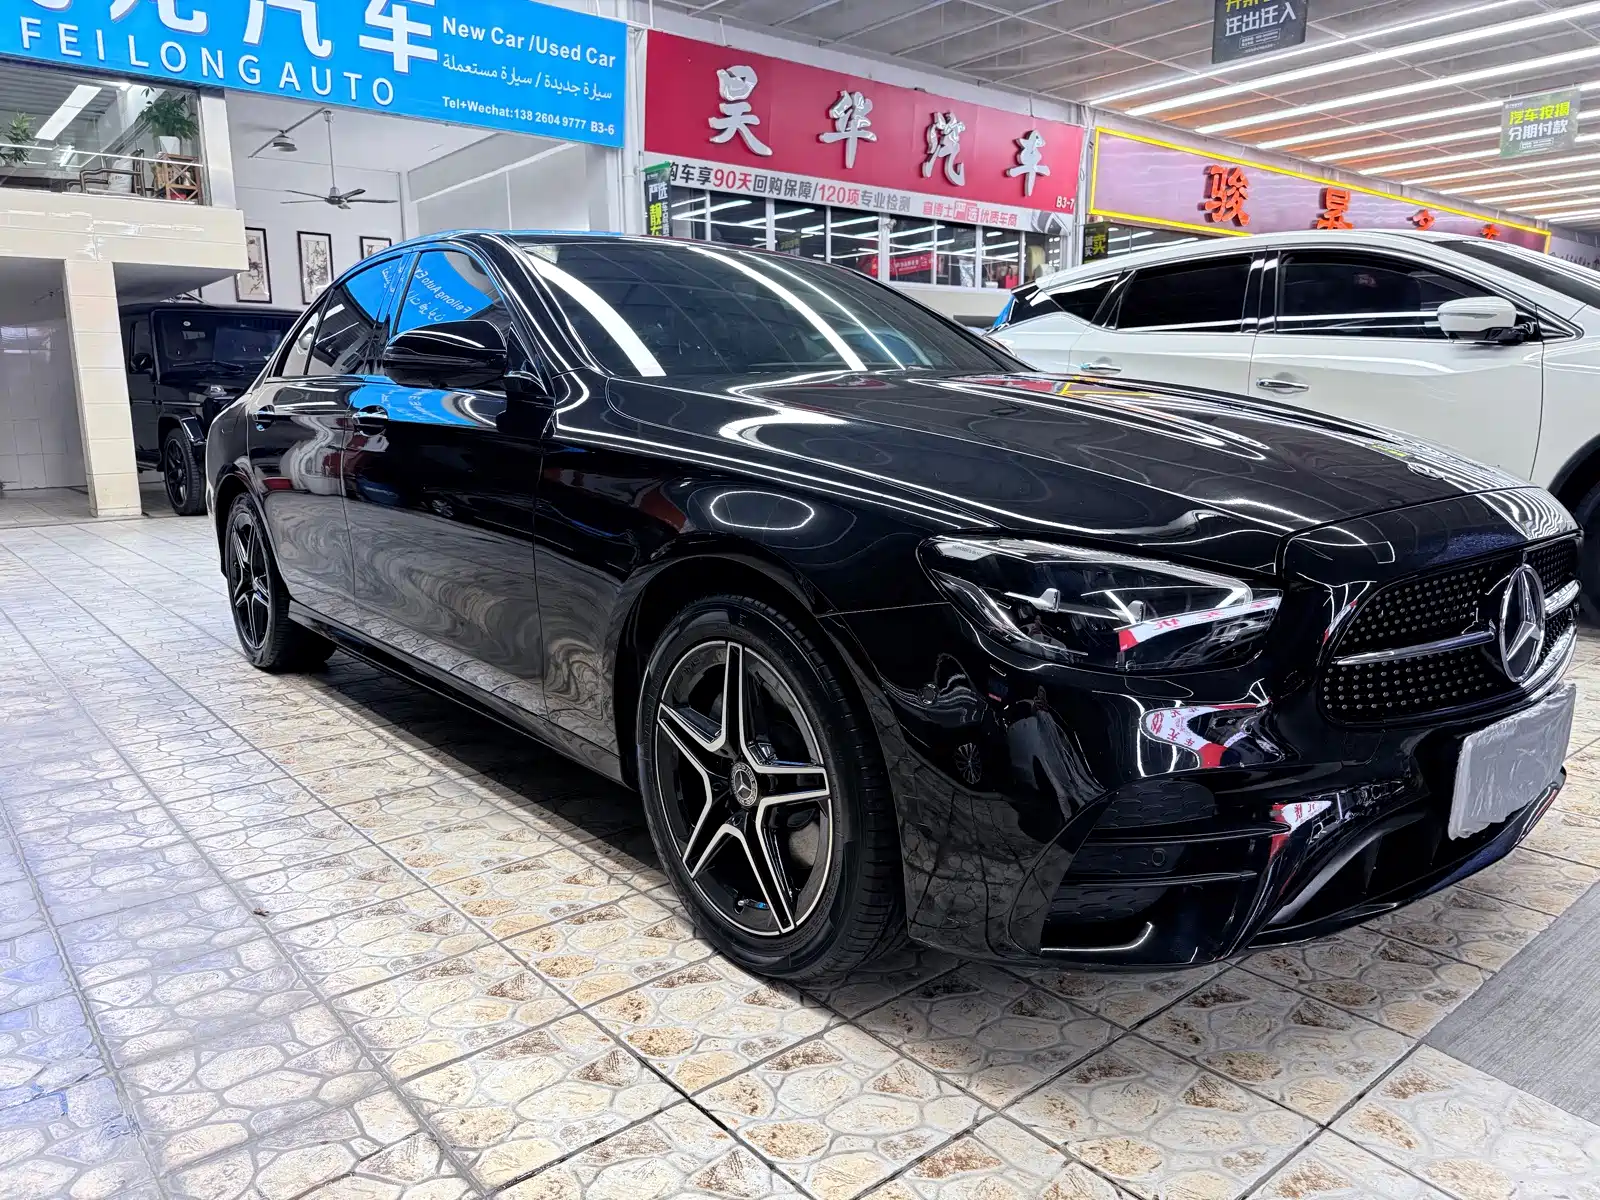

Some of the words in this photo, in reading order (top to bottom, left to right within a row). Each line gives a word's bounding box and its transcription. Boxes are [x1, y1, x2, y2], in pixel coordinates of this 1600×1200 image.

[443, 15, 486, 42] New
[490, 26, 525, 49] Car
[586, 47, 616, 68] Car
[442, 53, 498, 79] مستعملة
[500, 66, 533, 87] سيارة
[278, 61, 394, 106] AUTO
[544, 74, 581, 97] جديدة
[583, 82, 613, 101] سيارة
[535, 111, 561, 127] 2604
[562, 117, 587, 130] 9777
[1509, 100, 1571, 126] 汽车按揭
[590, 120, 616, 136] B3-6
[1508, 118, 1569, 142] 分期付款
[1056, 195, 1076, 211] B3-7
